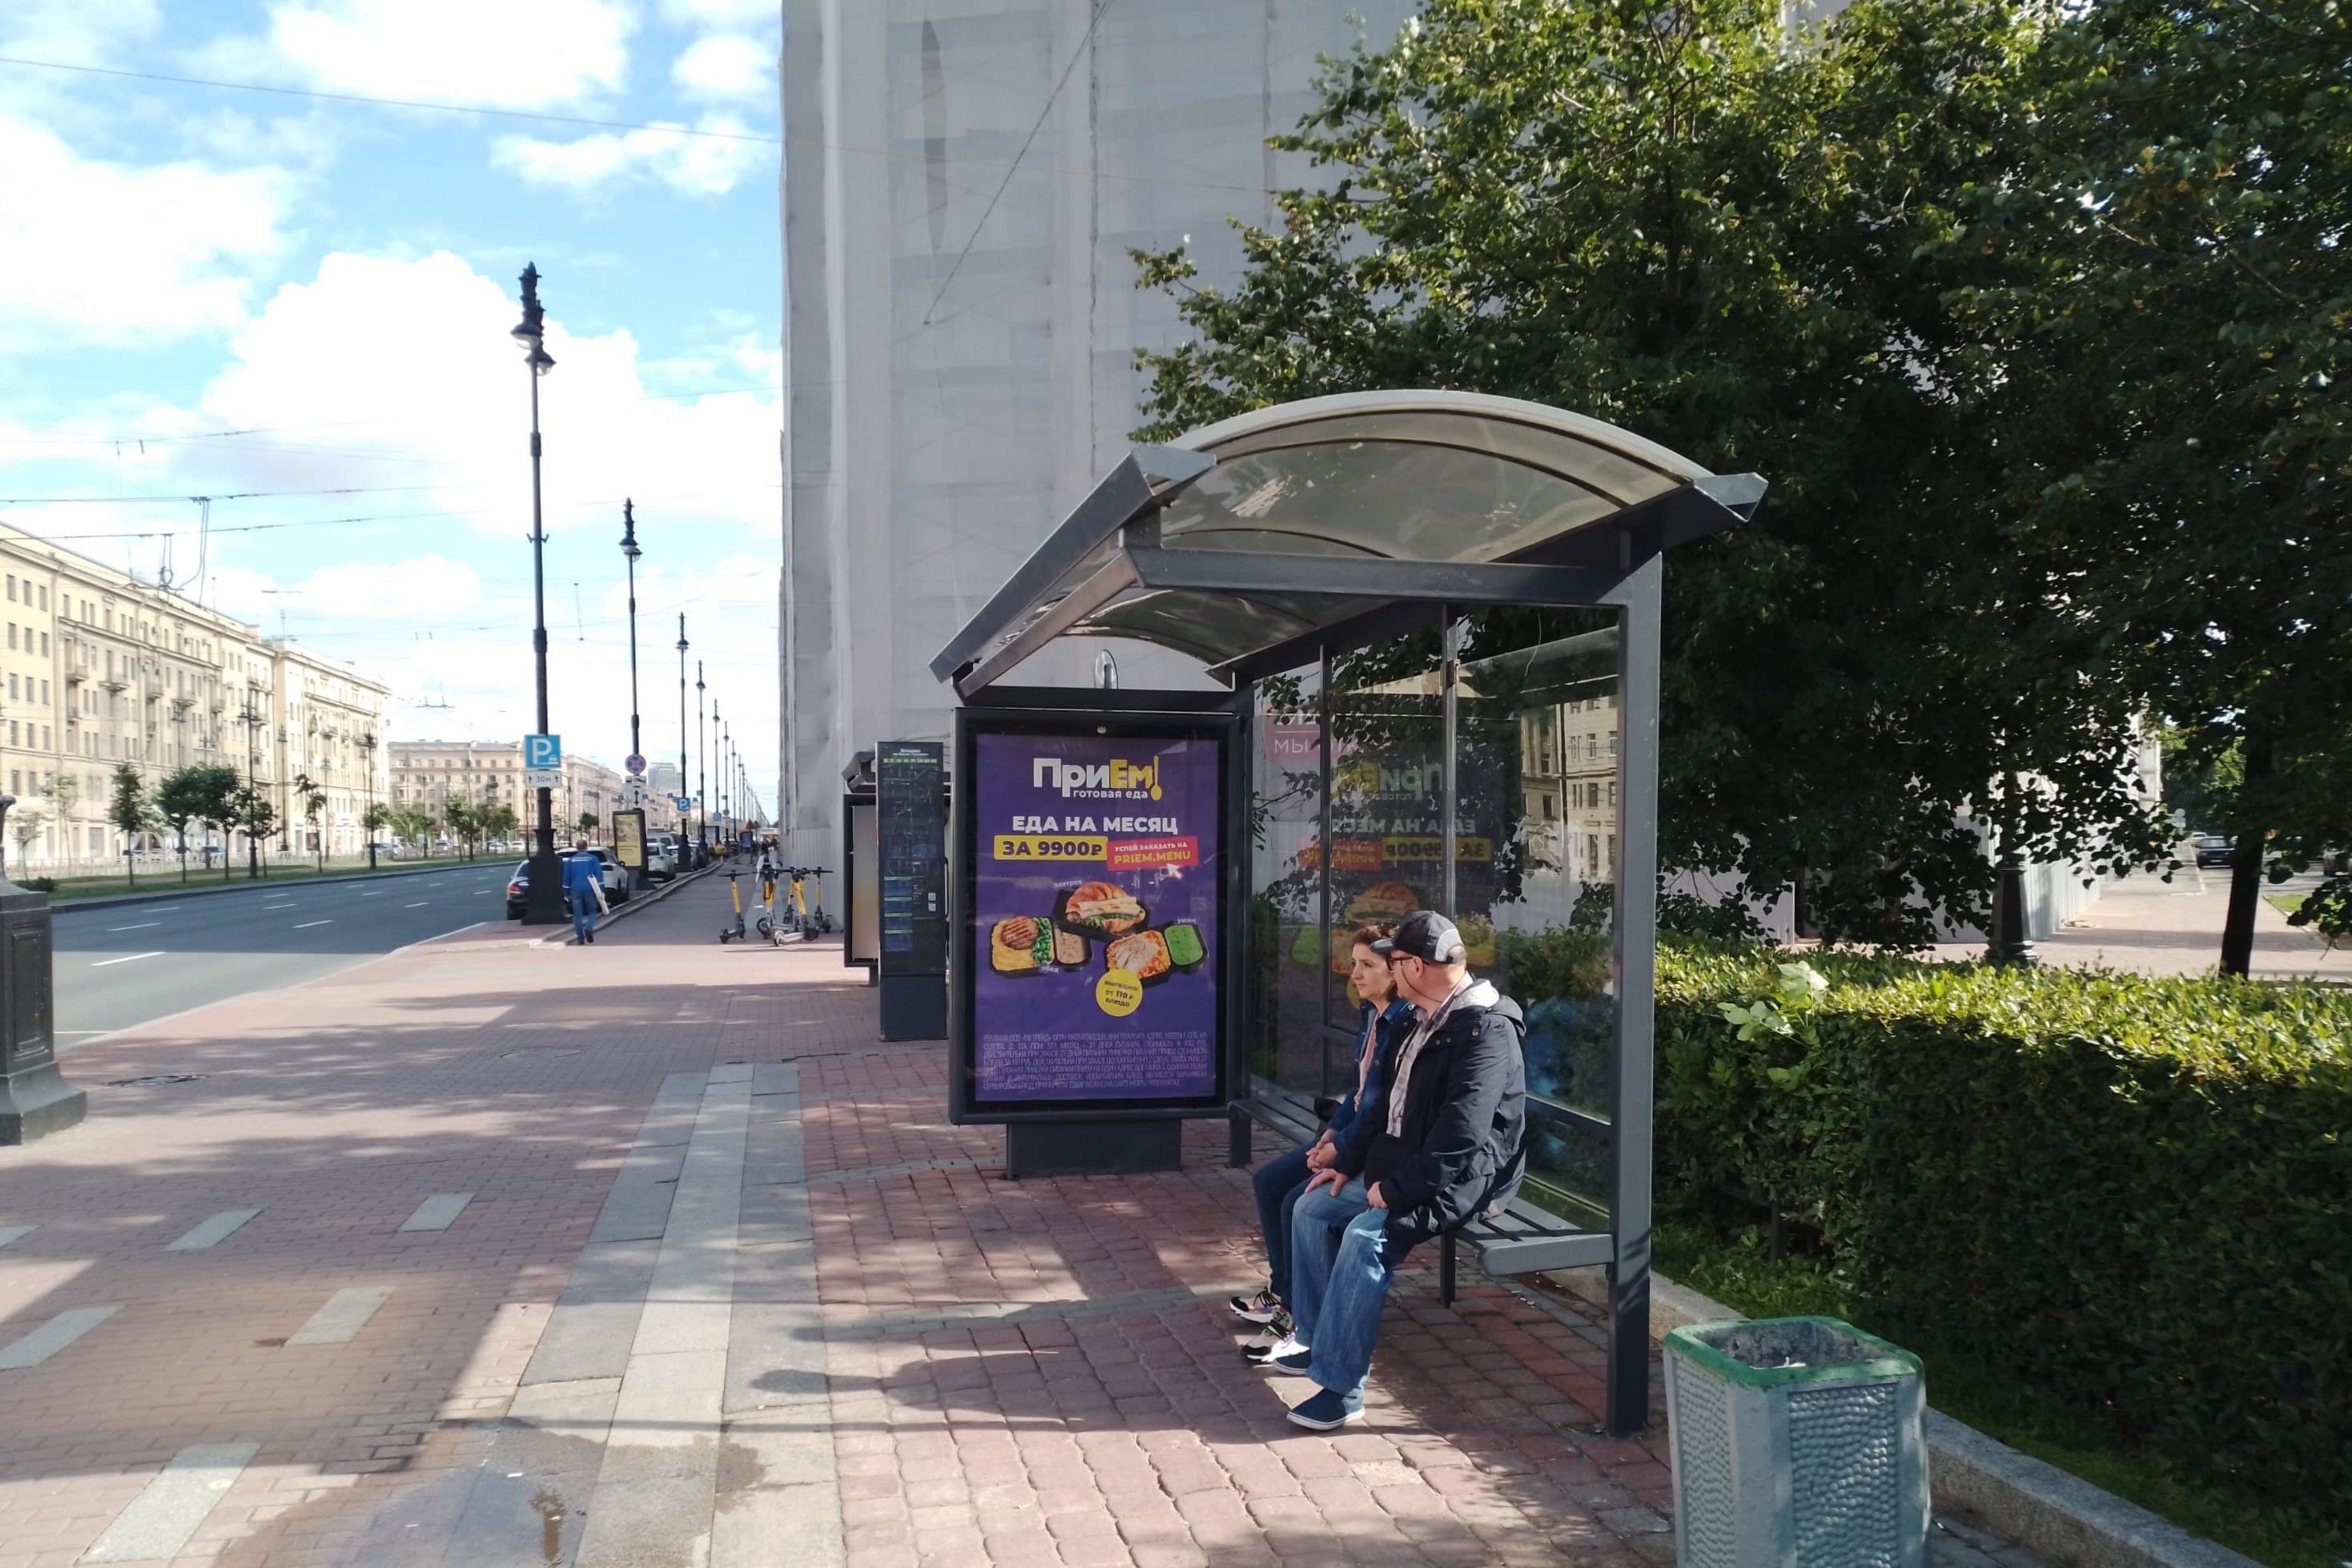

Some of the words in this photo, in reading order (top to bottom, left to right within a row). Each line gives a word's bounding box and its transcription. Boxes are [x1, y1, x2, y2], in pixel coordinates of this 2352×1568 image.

[1125, 790, 1148, 799] еда
[1012, 815, 1059, 834] ЕДА
[1065, 816, 1097, 832] НА
[1103, 817, 1178, 835] МЕСЯЦ
[1003, 841, 1031, 856] ЗА
[1114, 843, 1139, 852] УСПЕЙ
[1140, 842, 1176, 850] ЗАКАЗАТЬ
[1114, 850, 1191, 864] PRIEM.MENU
